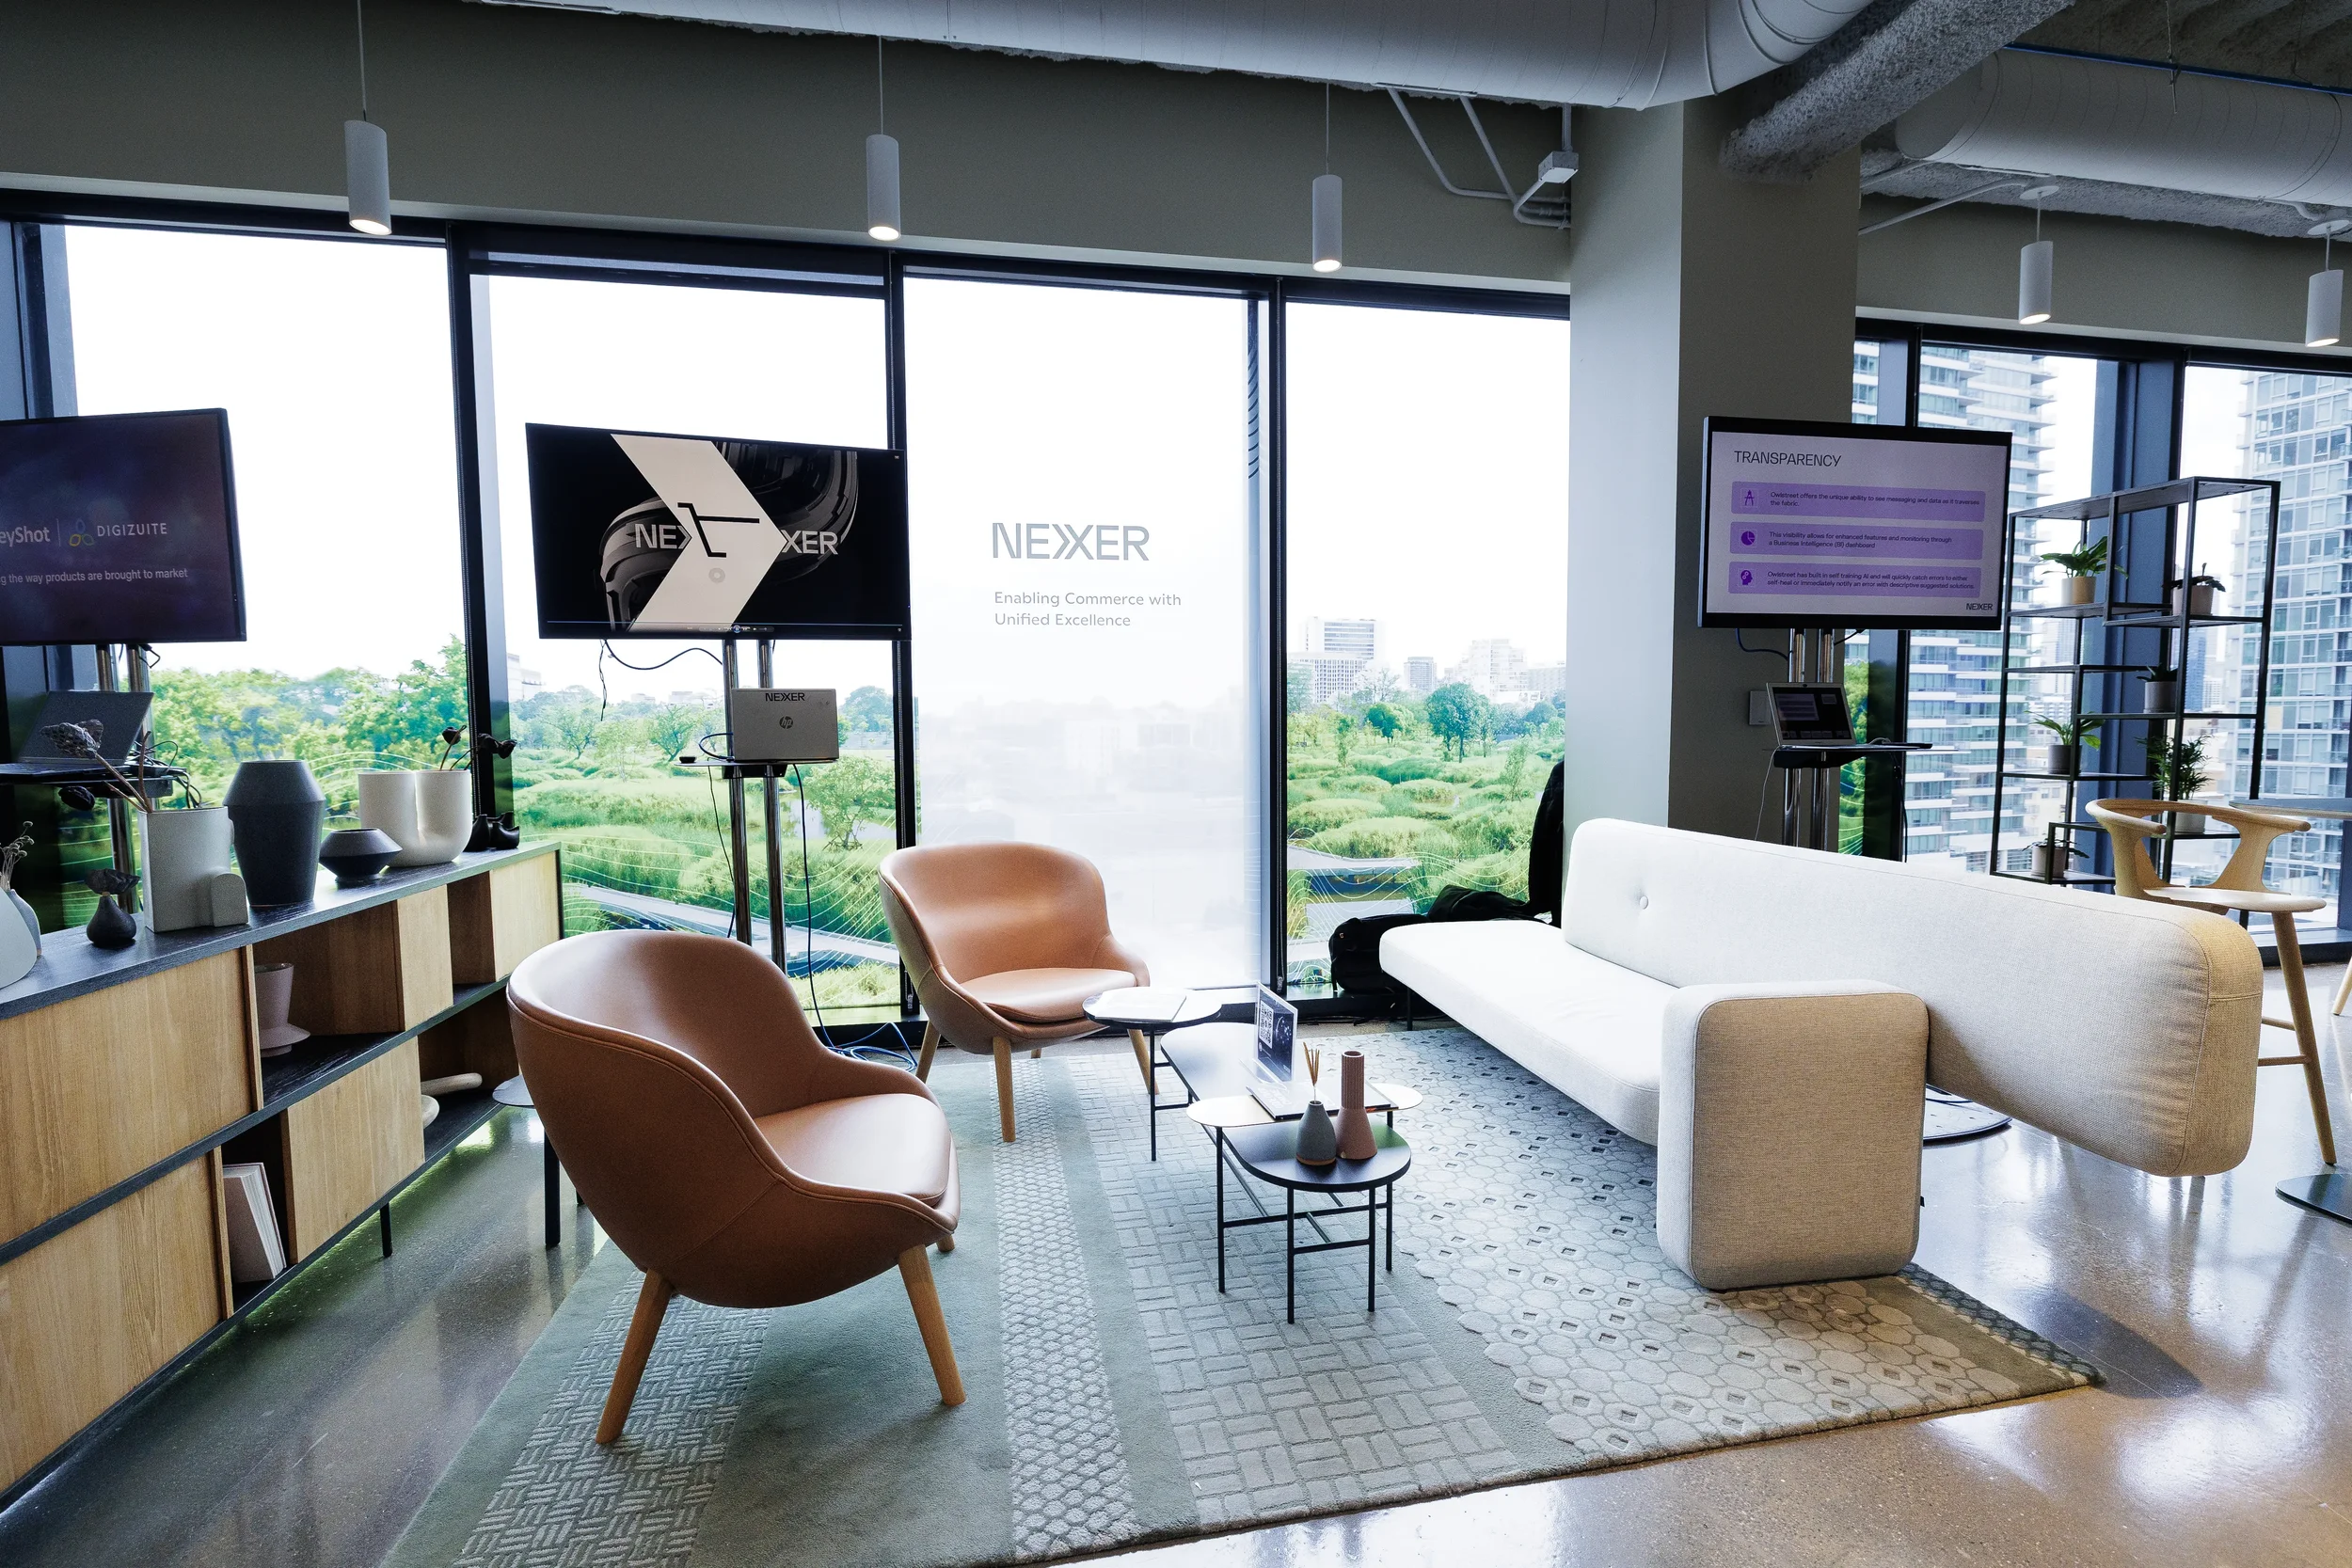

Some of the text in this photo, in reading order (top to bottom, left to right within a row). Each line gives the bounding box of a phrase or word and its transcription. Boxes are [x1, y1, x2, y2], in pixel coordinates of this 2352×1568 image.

[1733, 450, 1842, 467] TRANSPARENCY
[1850, 494, 1867, 502] ability
[97, 523, 168, 537] DIGIZUITE
[1782, 531, 1806, 540] visibility
[1801, 540, 1833, 548] Intelligence
[8, 573, 24, 583] the
[25, 574, 43, 585] way
[46, 572, 86, 584] products
[87, 572, 103, 581] are
[104, 570, 142, 582] brought
[143, 569, 152, 579] to
[155, 568, 188, 579] market
[1801, 579, 1836, 588] immediately
[994, 591, 1182, 608] Enabling Commerce with
[994, 612, 1132, 626] Unified Excellence
[780, 716, 793, 729] hp
